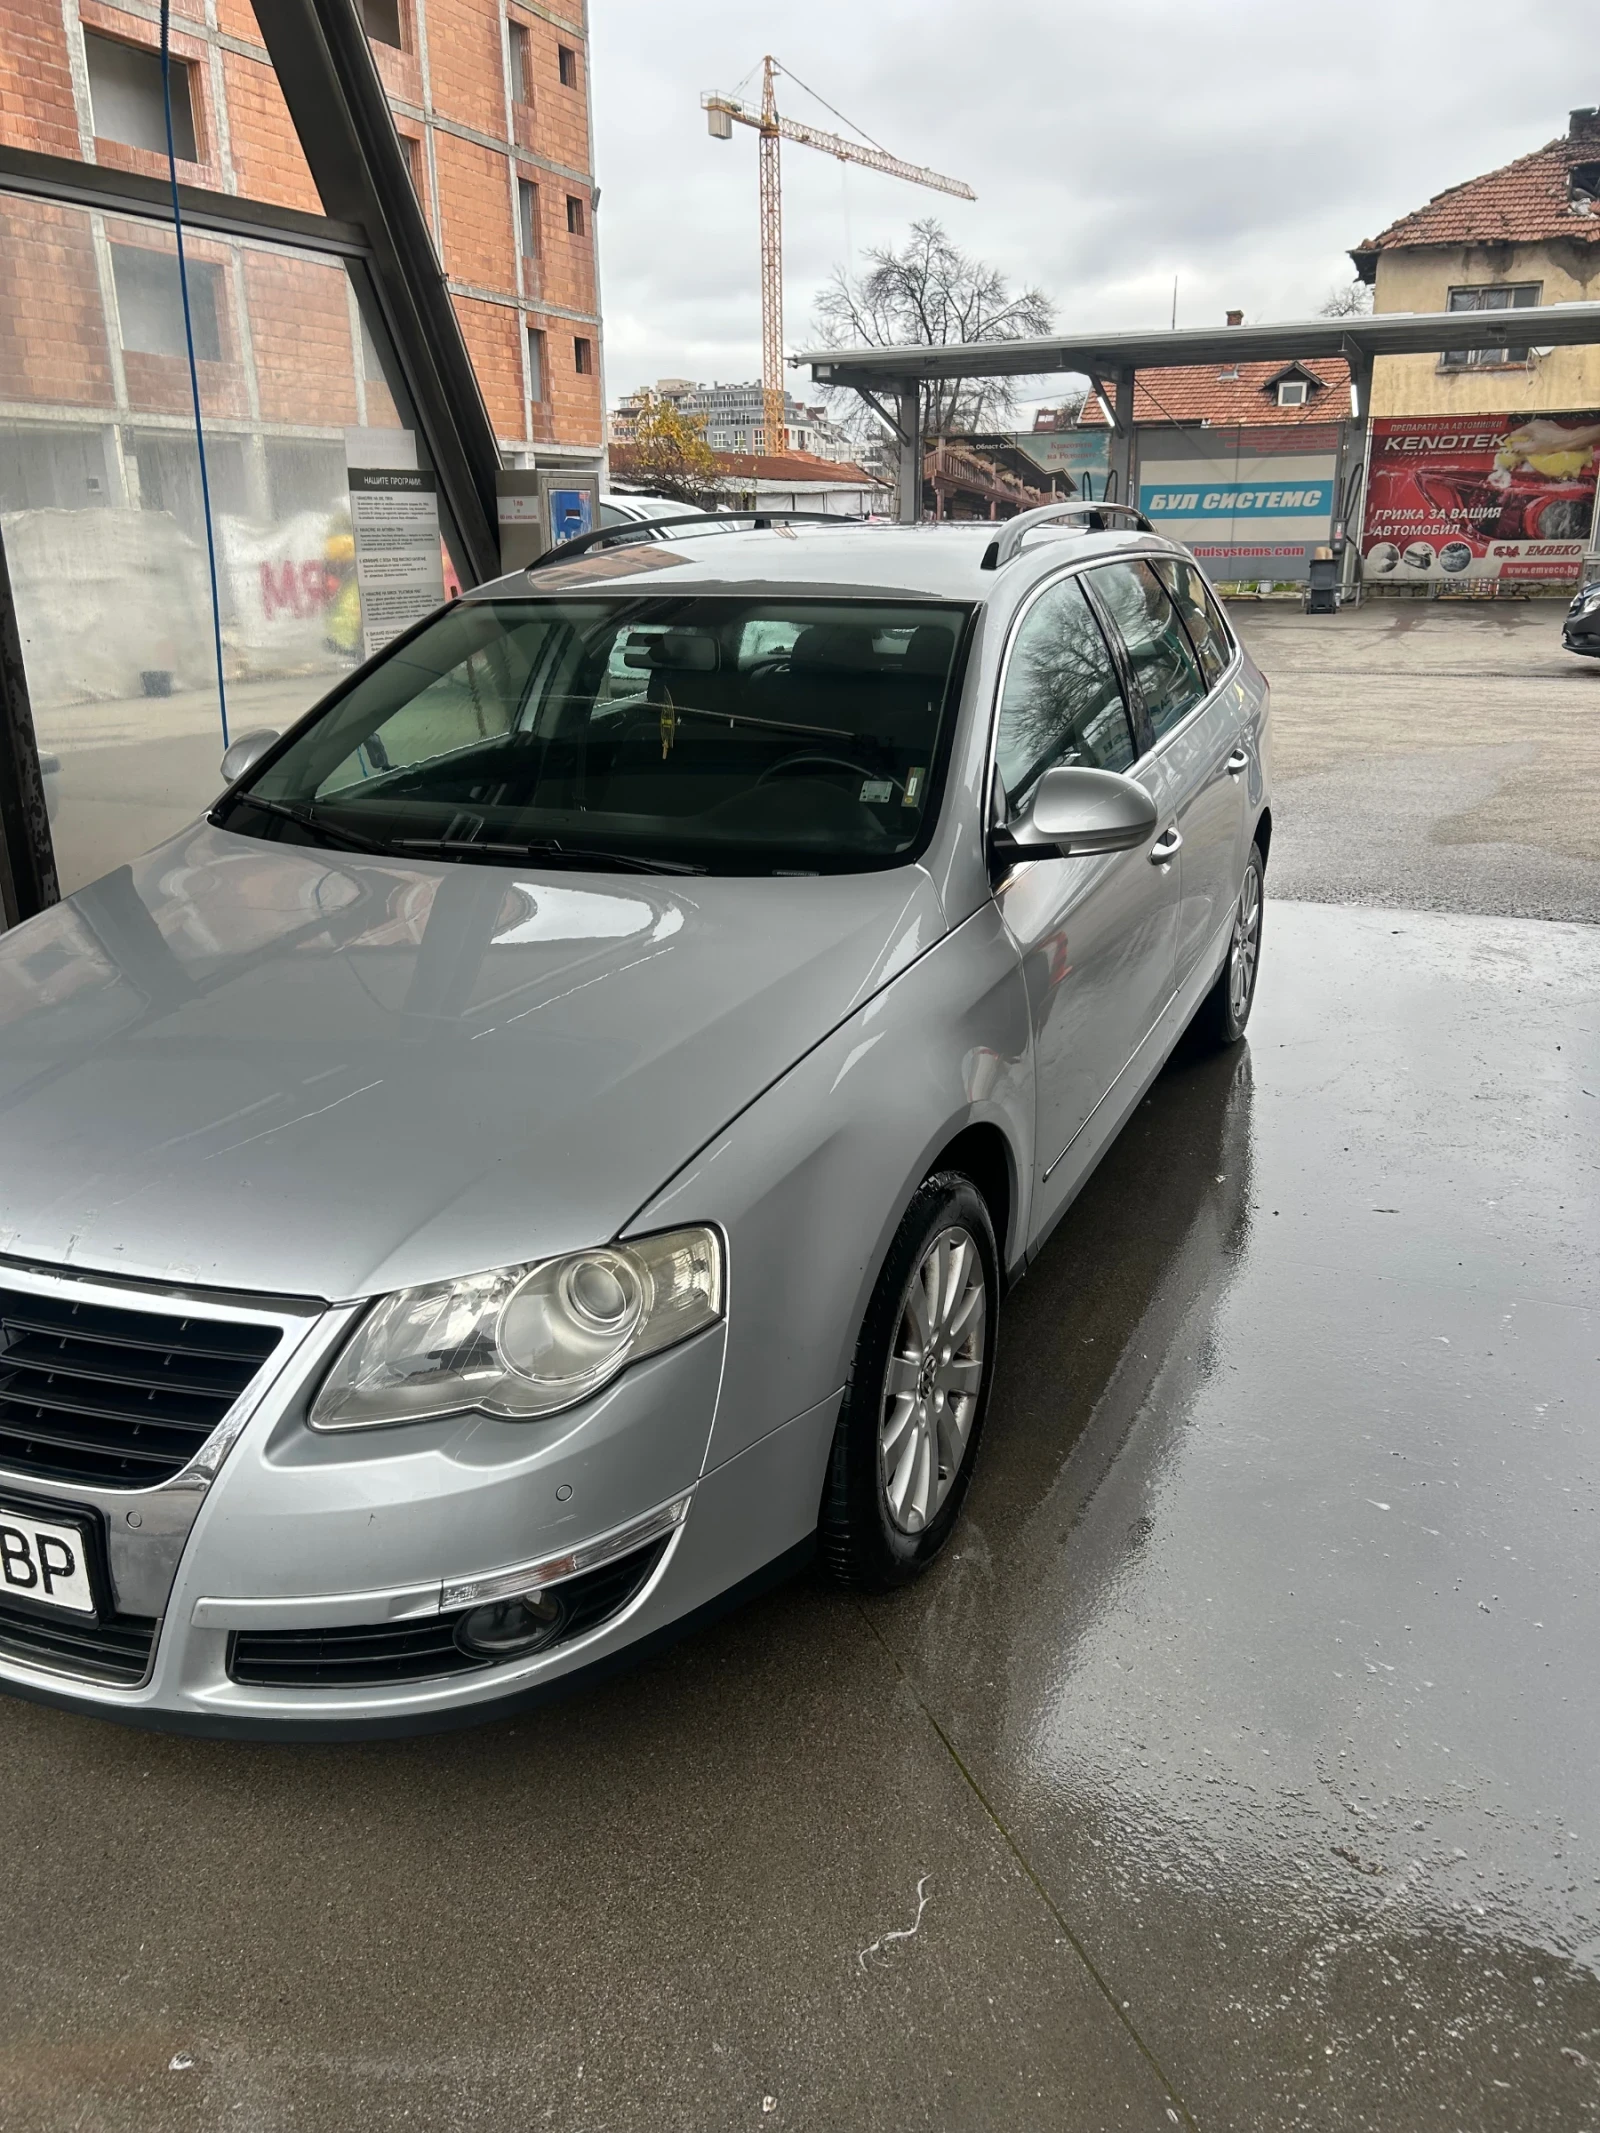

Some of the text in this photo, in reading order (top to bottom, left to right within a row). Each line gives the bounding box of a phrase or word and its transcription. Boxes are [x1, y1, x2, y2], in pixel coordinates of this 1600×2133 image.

[1390, 423, 1438, 432] ПРЕПАРАТИ
[1439, 422, 1450, 430] ЗА
[1384, 433, 1510, 451] KENOTEK
[363, 476, 389, 485] НАШИТЕ
[1149, 490, 1322, 510] БУЛ СИСТЕМС
[1374, 506, 1504, 521] ГРИЖА ЗА ВАШИЯ
[1372, 523, 1461, 537] АВТОМОБИЛ
[1507, 563, 1580, 577] www.emveco.bg
